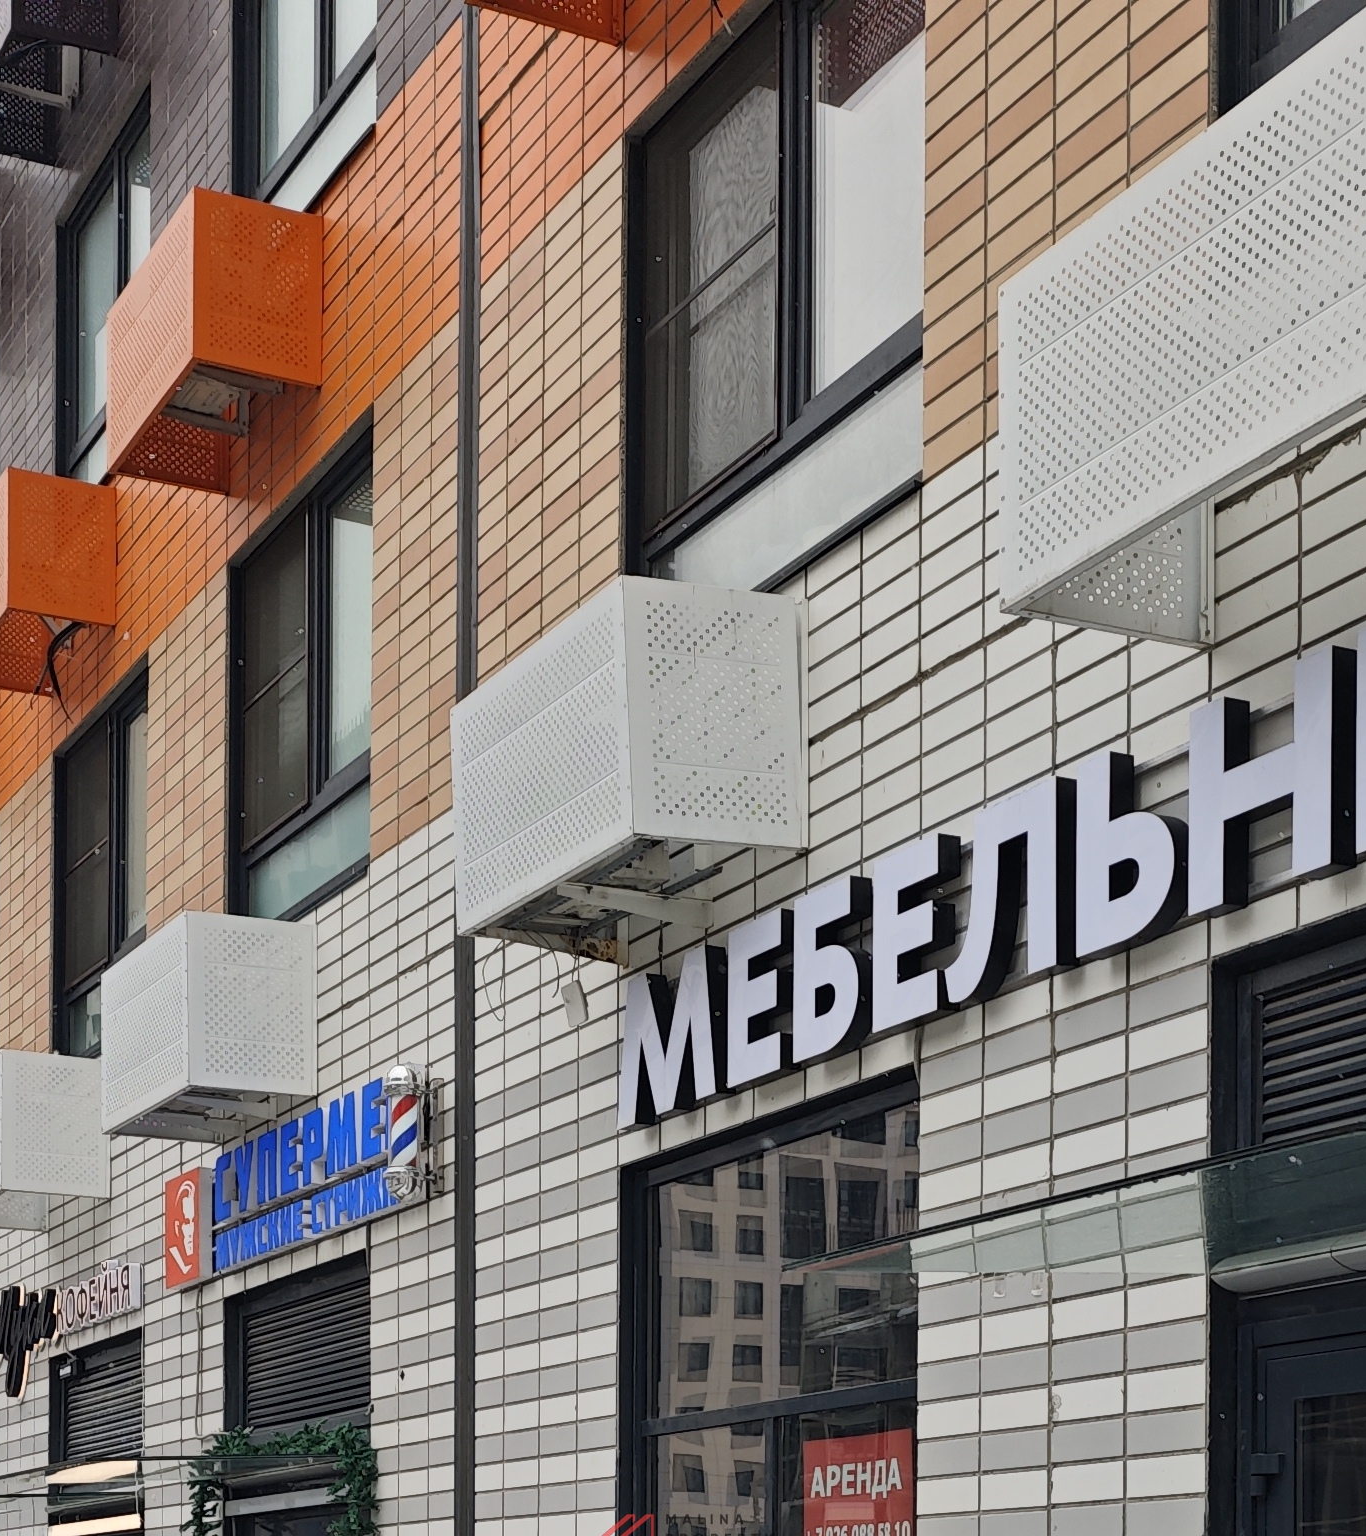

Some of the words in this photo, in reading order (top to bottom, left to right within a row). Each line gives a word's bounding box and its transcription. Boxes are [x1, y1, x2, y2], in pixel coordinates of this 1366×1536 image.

[214, 1077, 391, 1224] СУПЕРМЕ
[215, 1200, 304, 1273] МУЖСКИЕ
[56, 1259, 135, 1334] КОФЕЙНЯ
[810, 1457, 903, 1500] АРЕНДА
